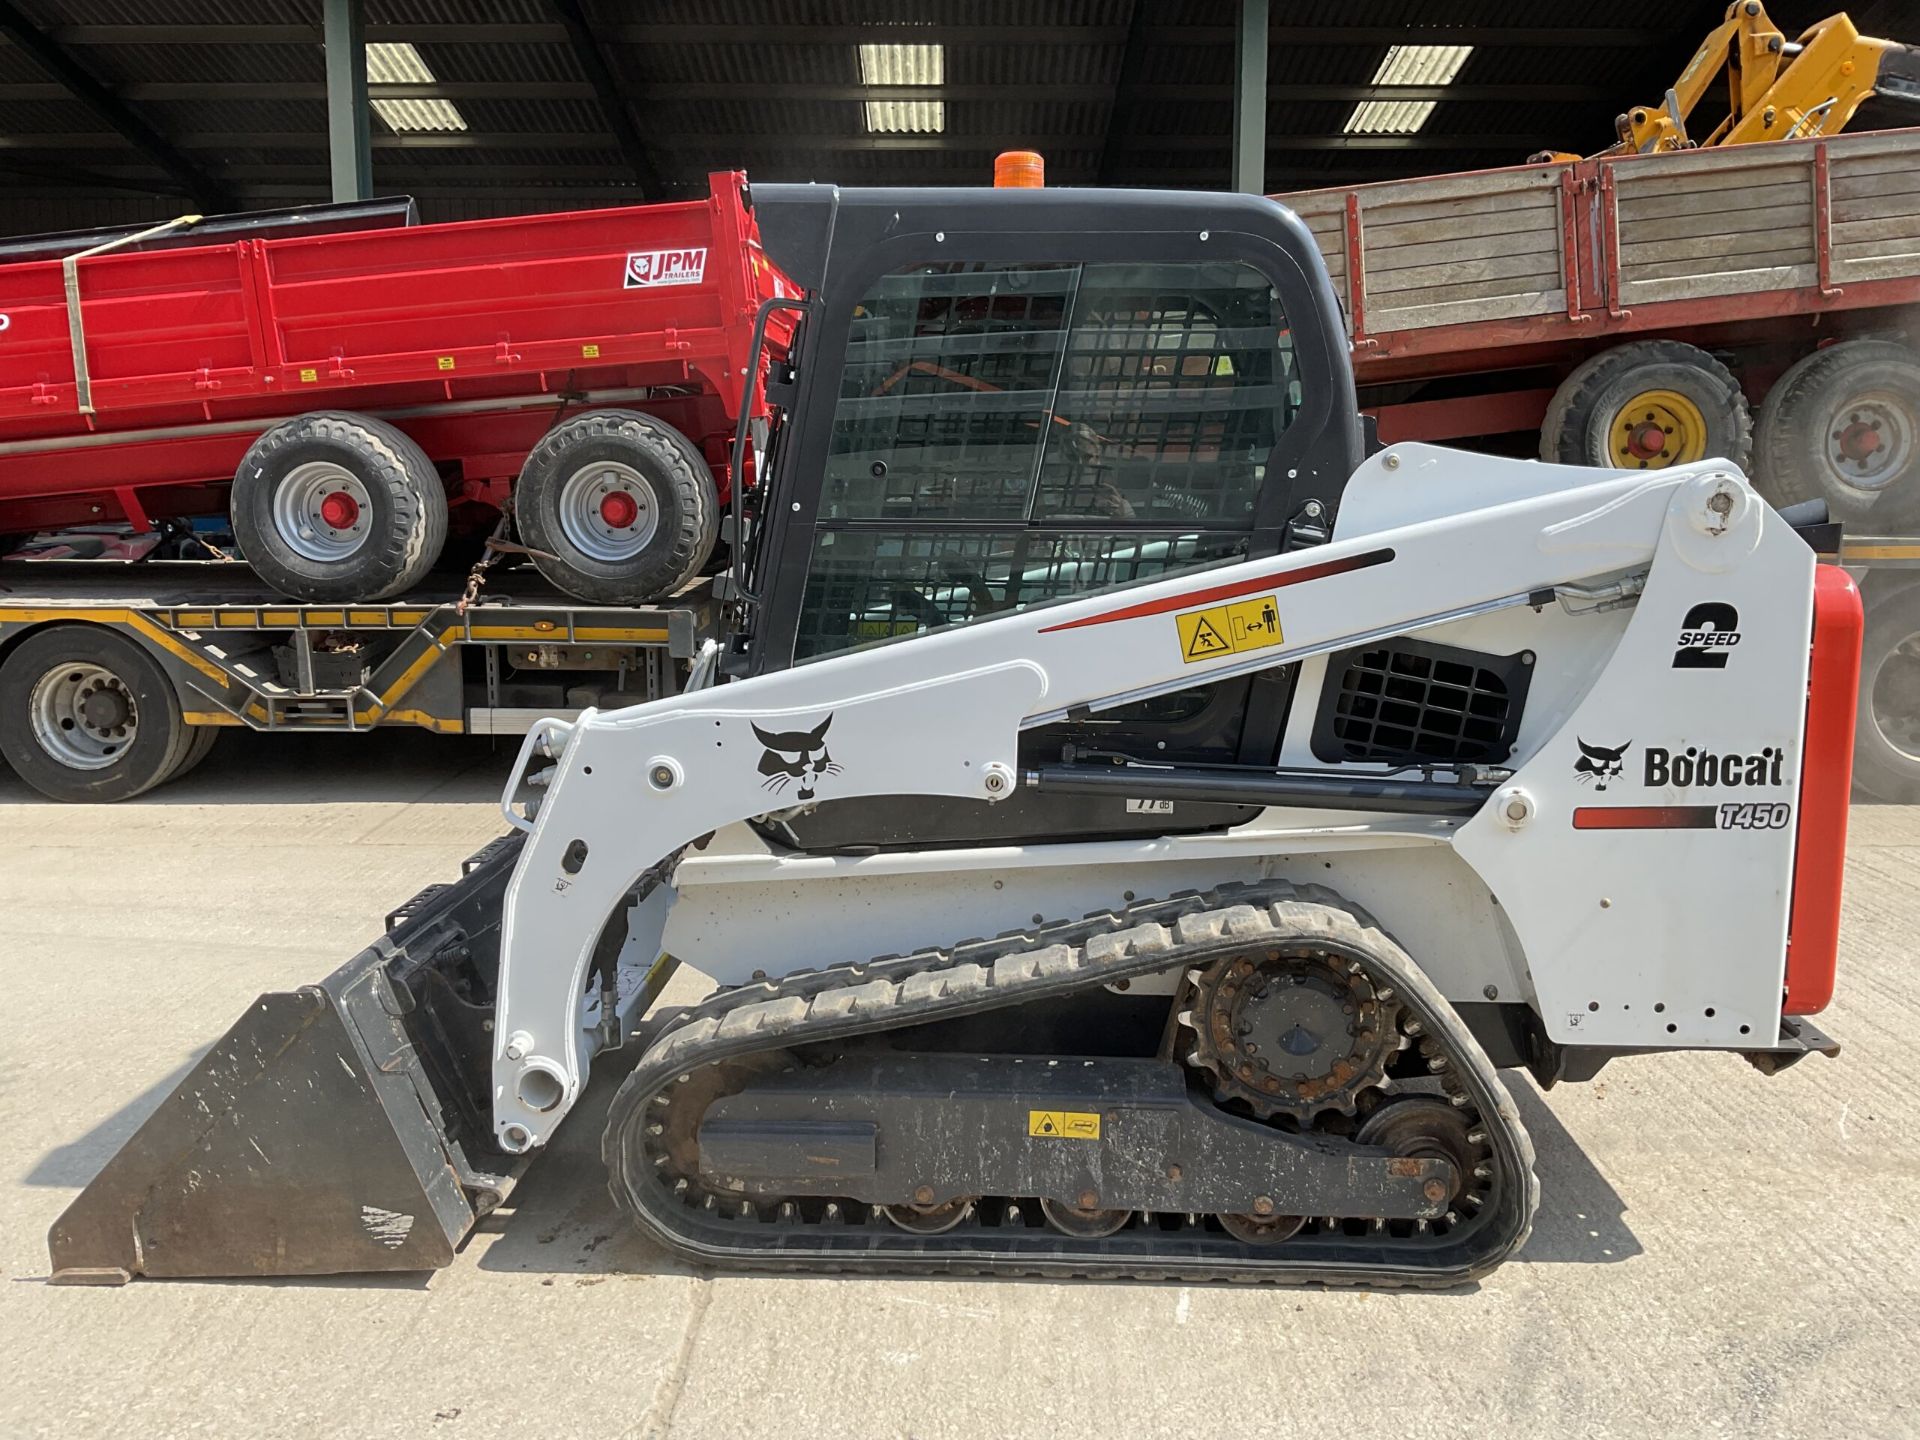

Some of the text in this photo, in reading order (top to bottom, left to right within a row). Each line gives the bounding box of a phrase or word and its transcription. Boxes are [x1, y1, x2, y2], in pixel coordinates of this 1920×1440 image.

[652, 250, 704, 280] JPM
[664, 270, 701, 280] TRAILERS
[1672, 602, 1738, 668] 2
[1677, 632, 1741, 646] SPEED
[1644, 747, 1784, 788] Bobcat
[1720, 803, 1791, 829] T450
